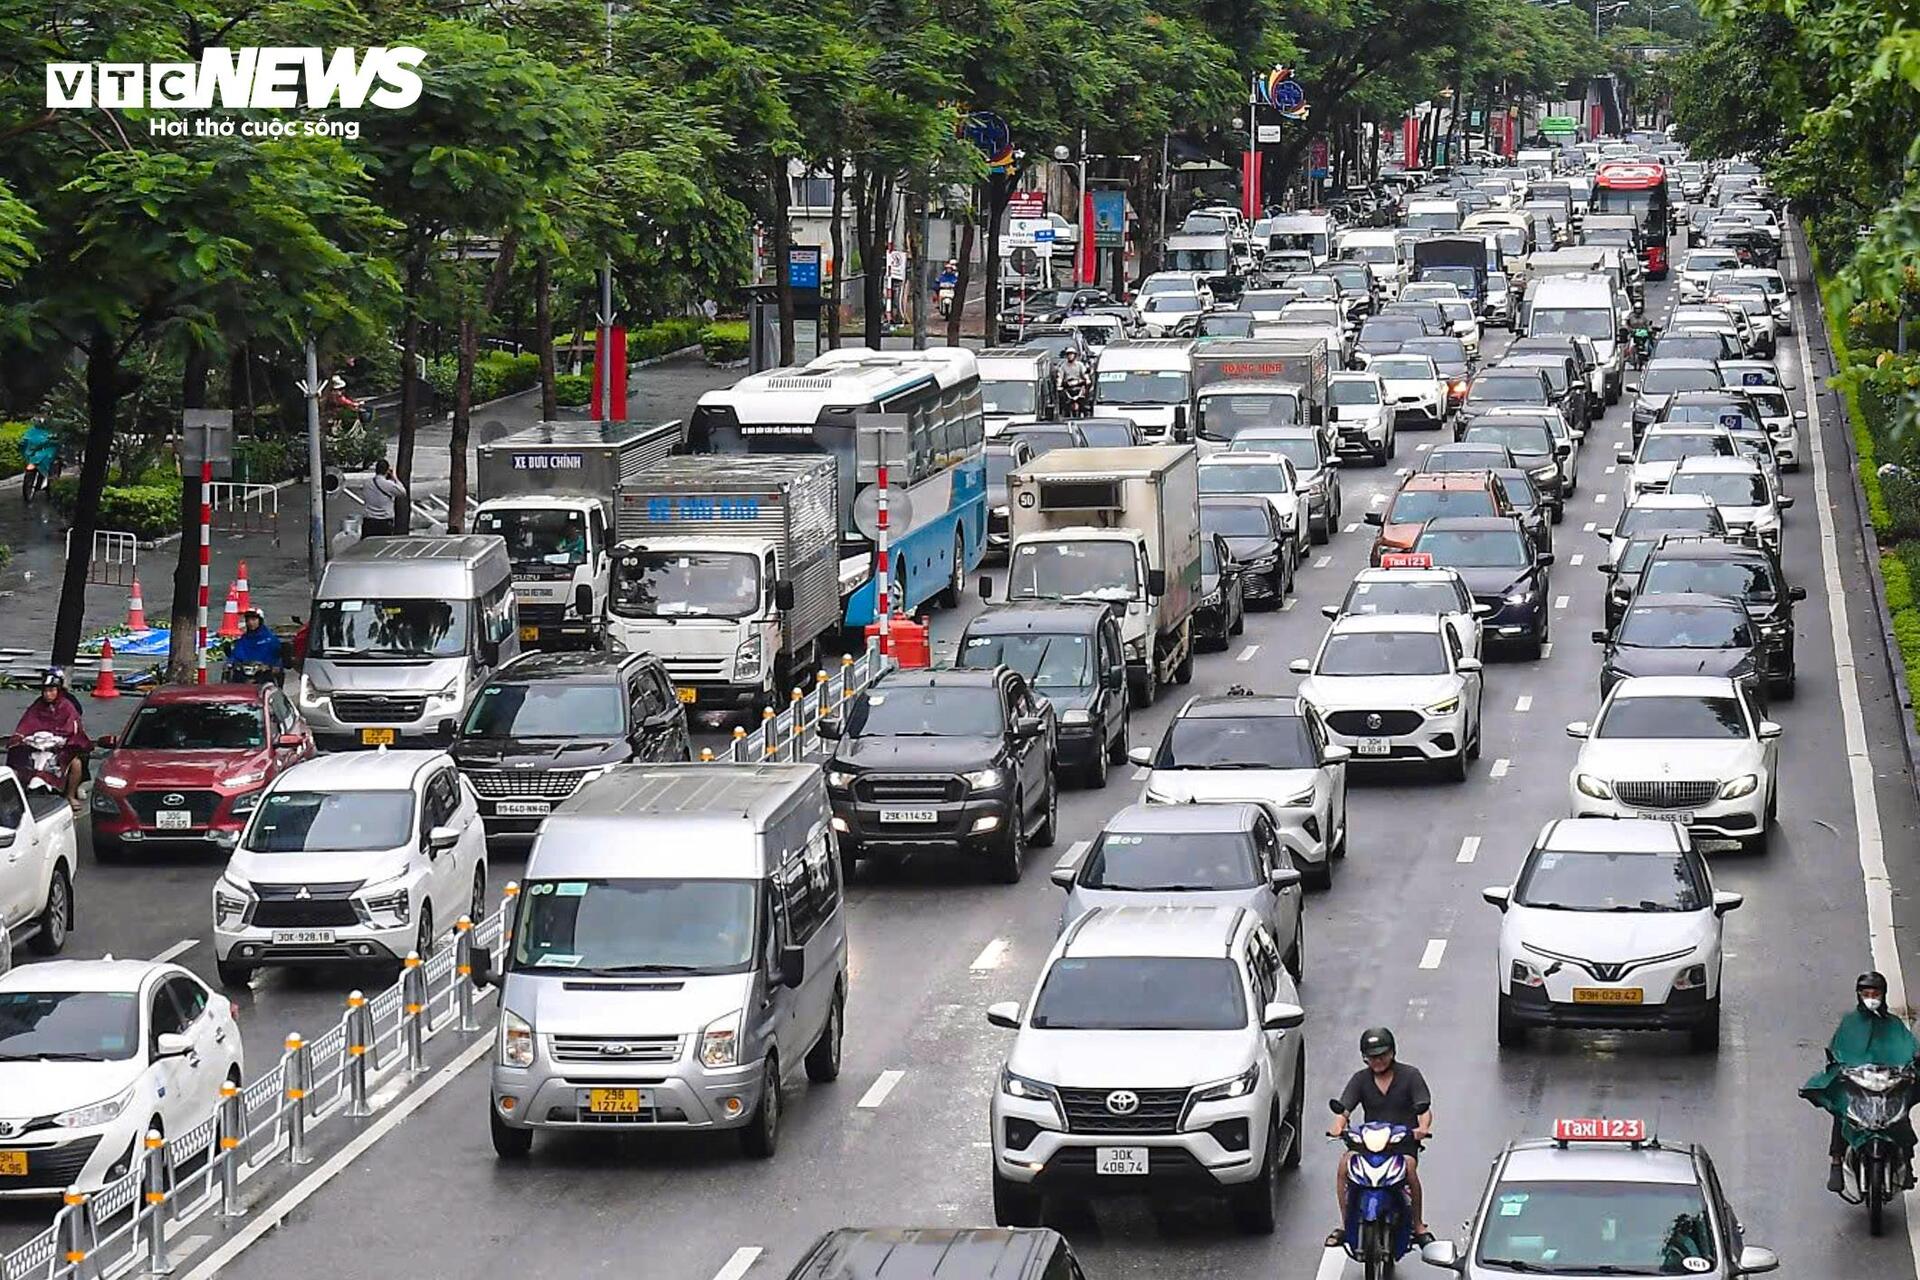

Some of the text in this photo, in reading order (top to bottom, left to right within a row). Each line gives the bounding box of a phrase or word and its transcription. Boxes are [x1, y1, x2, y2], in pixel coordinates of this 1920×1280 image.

[514, 455, 526, 469] XE
[550, 453, 581, 469] CHÍNH
[1020, 494, 1034, 506] 50
[1408, 556, 1425, 567] 123
[1560, 1119, 1639, 1137] Taxi 123
[1111, 1149, 1133, 1160] 30K
[1102, 1161, 1143, 1173] 408.74
